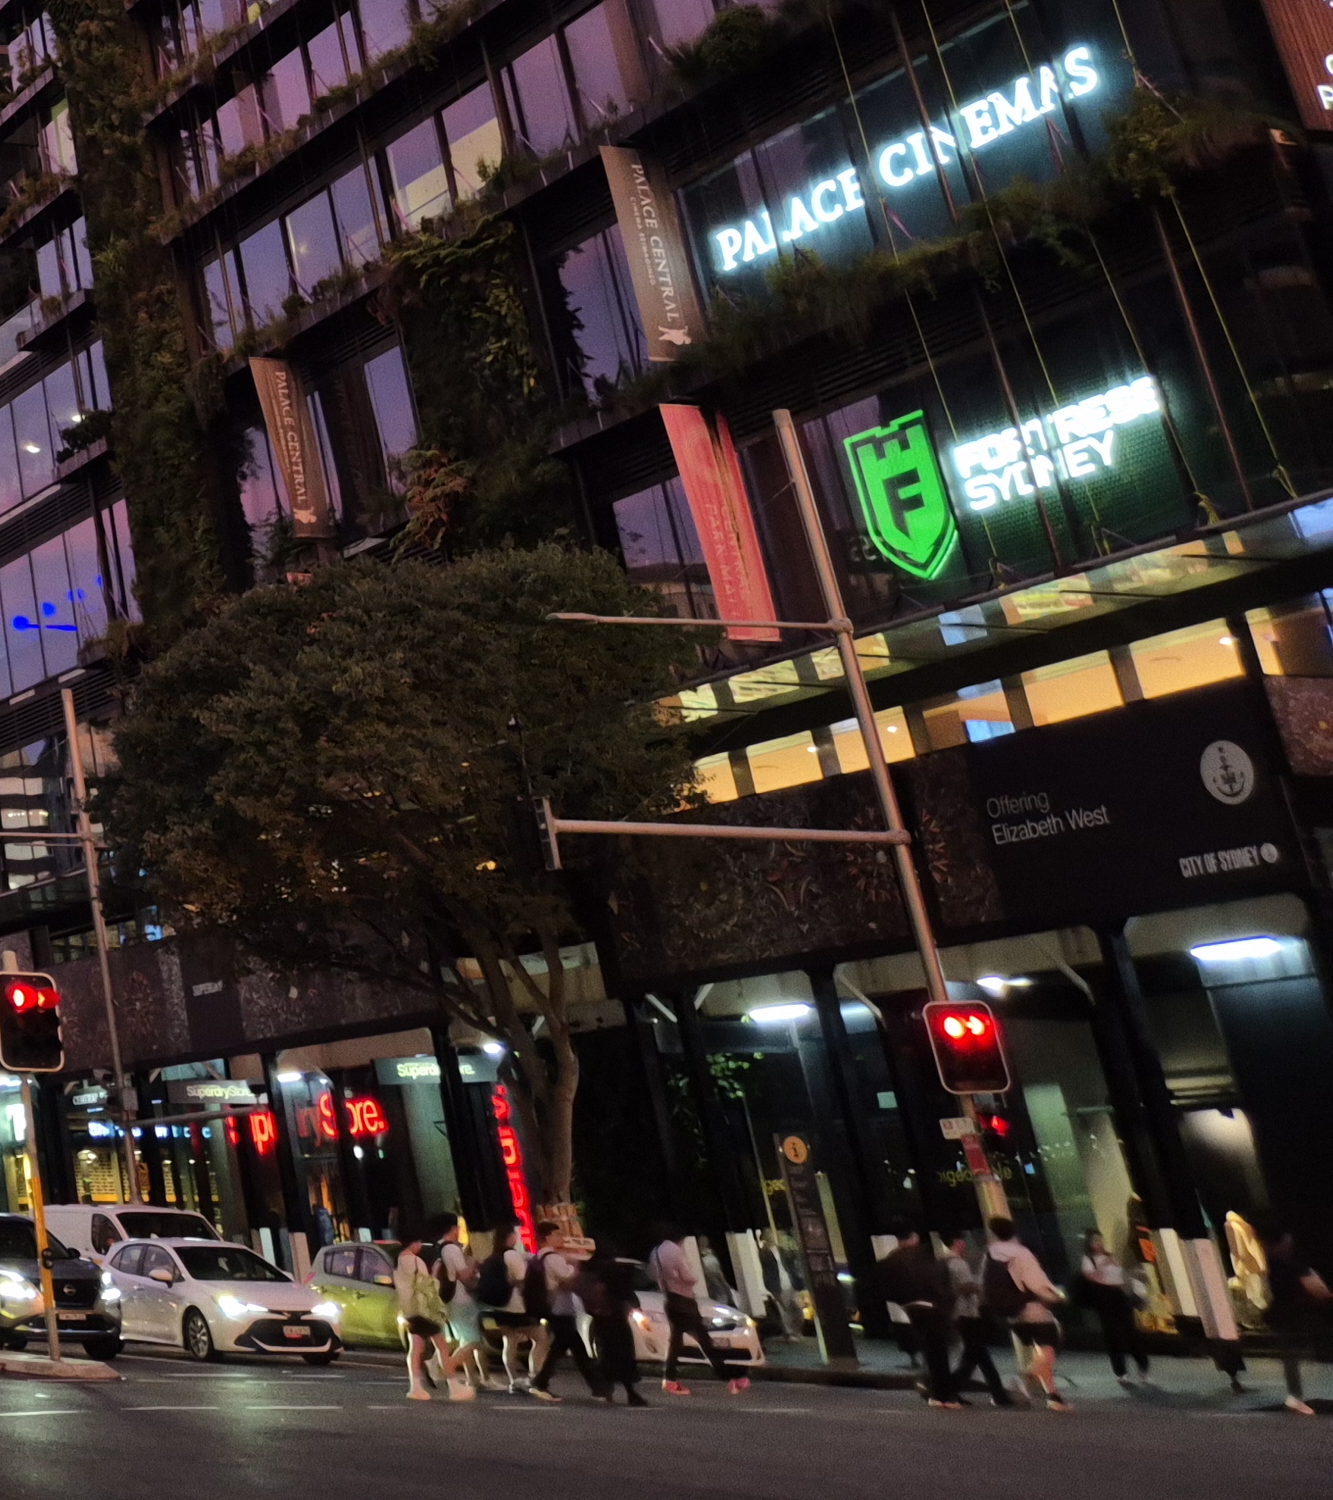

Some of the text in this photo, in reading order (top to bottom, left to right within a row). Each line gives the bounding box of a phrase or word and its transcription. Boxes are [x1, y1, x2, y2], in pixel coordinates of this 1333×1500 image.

[714, 43, 1101, 276] PALACE CINEMAS
[630, 163, 681, 322] PALACE CENTRAL
[275, 371, 296, 428] PALACE
[286, 431, 309, 504] CENTRAL
[986, 791, 1050, 819] Offering
[991, 804, 1110, 845] Elizabeth West
[1179, 845, 1259, 879] CITY OF SYDNEY
